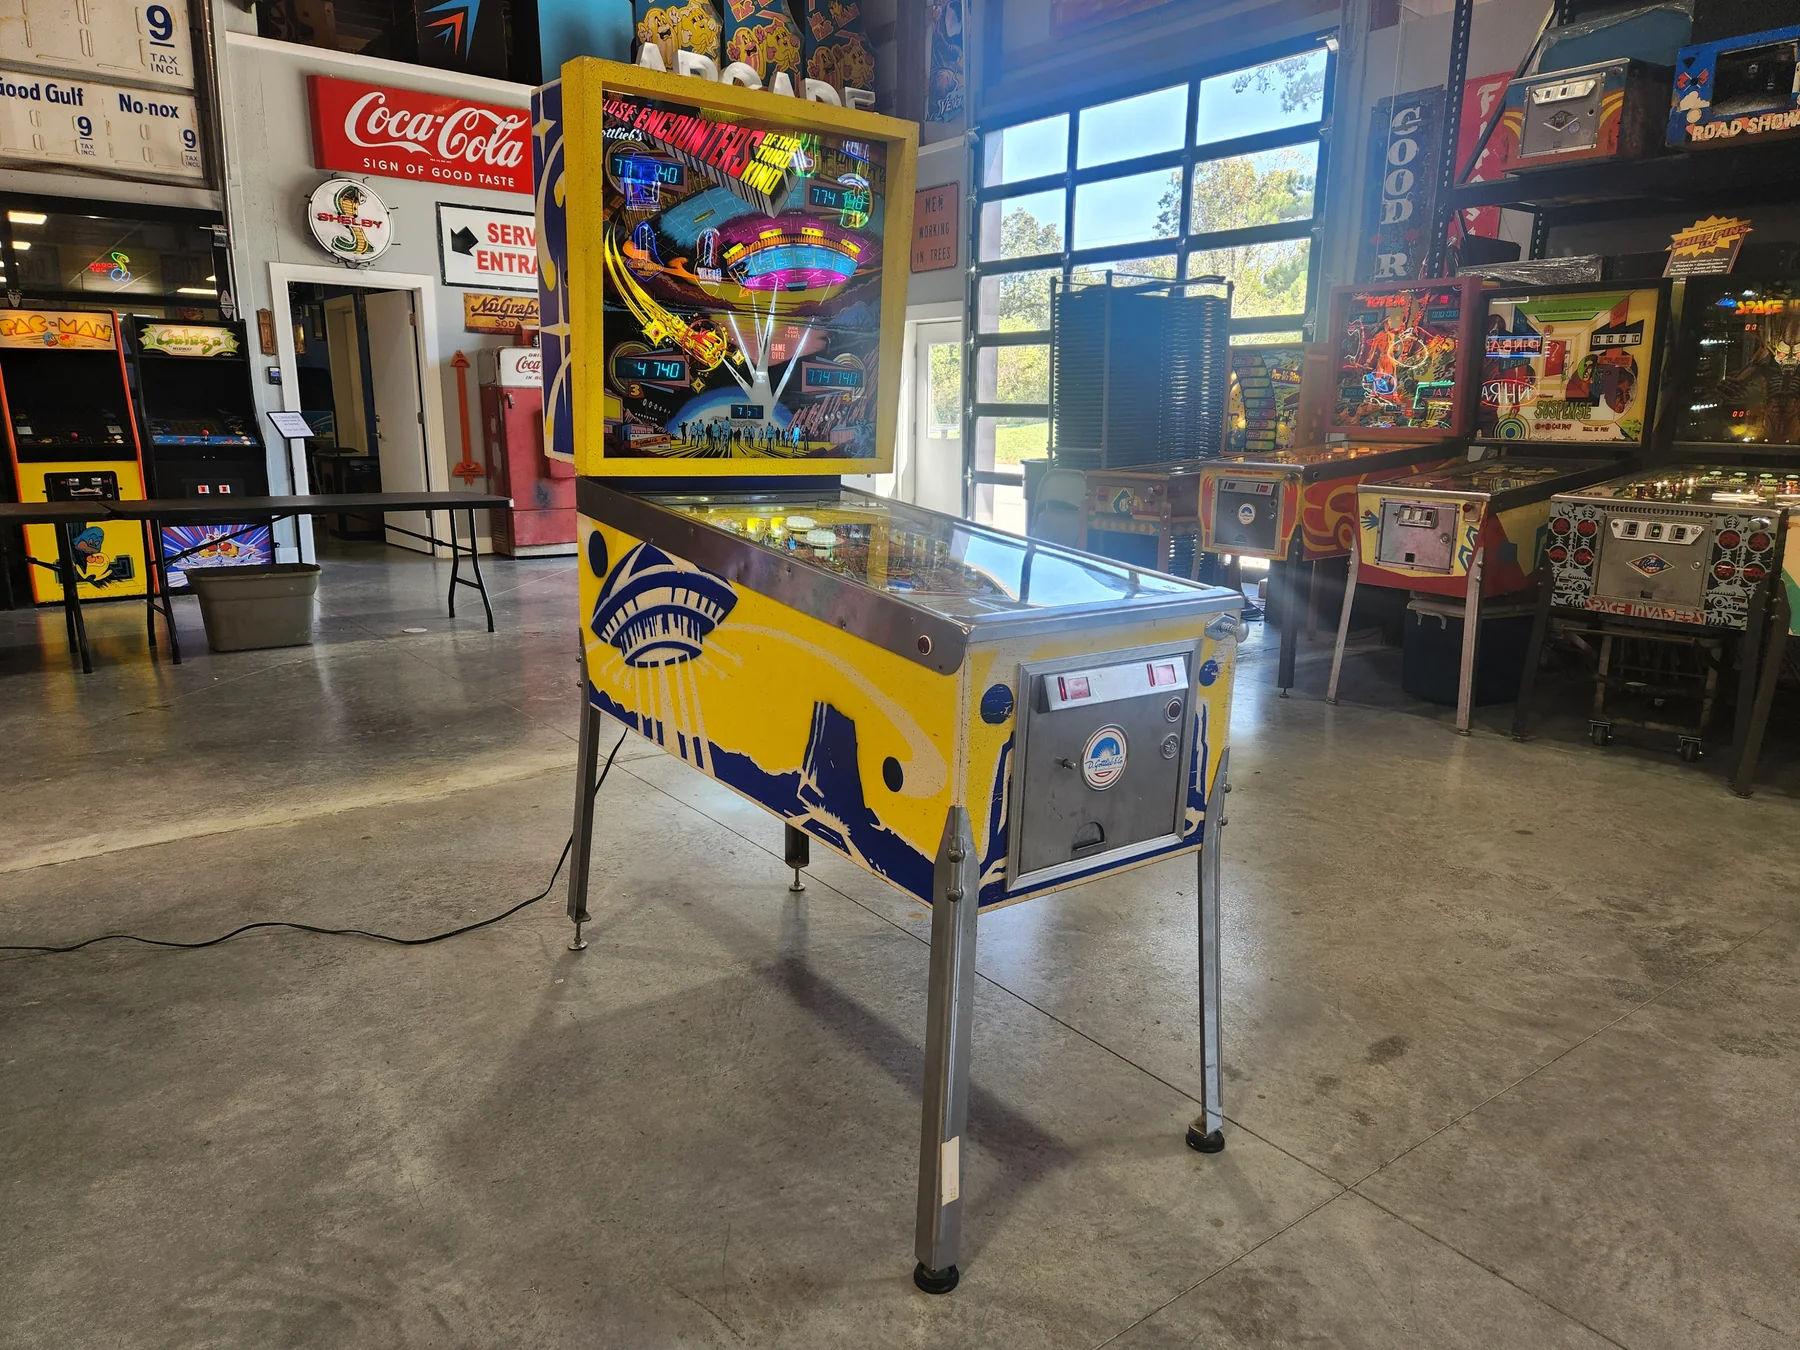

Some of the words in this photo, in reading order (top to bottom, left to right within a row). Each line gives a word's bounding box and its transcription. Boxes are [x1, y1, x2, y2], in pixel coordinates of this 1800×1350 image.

[146, 5, 173, 41] 9
[150, 53, 178, 65] TAX
[150, 63, 183, 76] INCL.
[45, 84, 84, 106] Gulf
[77, 116, 92, 137] 9
[344, 91, 529, 169] Coca-Cola
[601, 126, 643, 142] ottlieb's
[1691, 119, 1743, 142] ROAD
[1746, 111, 1800, 135] SHOW
[80, 142, 94, 150] TAX
[183, 129, 196, 149] 9
[602, 98, 637, 122] LOSE
[633, 107, 766, 179] ENCOUNTERS
[762, 133, 778, 145] OF
[775, 134, 801, 152] THE
[755, 145, 793, 169] THIRD
[363, 157, 399, 172] SIGN
[405, 164, 425, 175] OF
[431, 167, 472, 182] GOOD
[478, 173, 515, 187] TASTE
[739, 160, 784, 196] KIND
[925, 195, 943, 214] MEN
[316, 212, 383, 229] SHELBY
[919, 222, 950, 240] WORKING
[1672, 233, 1711, 249] CHIEF
[1714, 223, 1749, 239] PINS
[916, 250, 924, 264] IN
[930, 246, 951, 261] TREES
[1365, 294, 1406, 308] TOTEM
[1735, 300, 1784, 315] SPACE
[0, 314, 113, 342] PAC-MAN
[156, 328, 223, 355] Galaga
[771, 343, 786, 351] GAME
[771, 351, 785, 360] OVER
[637, 361, 647, 376] 4
[653, 361, 680, 378] 740
[630, 384, 640, 396] 3
[842, 393, 852, 402] 4
[1534, 399, 1593, 420] SUSPENSE
[1584, 600, 1625, 616] SPACE
